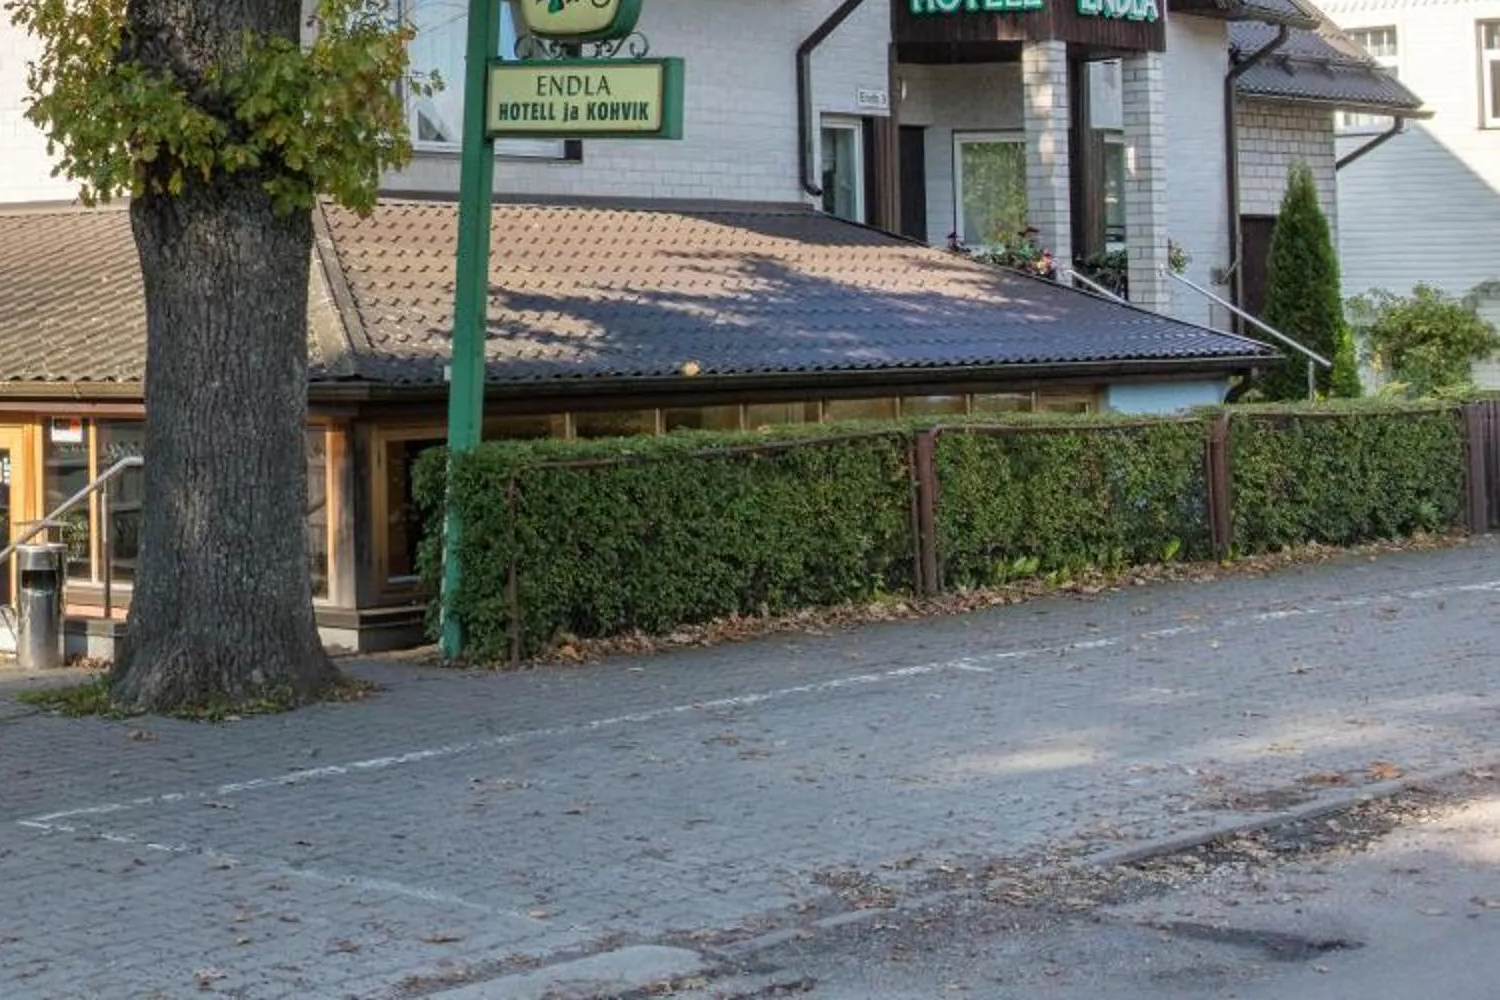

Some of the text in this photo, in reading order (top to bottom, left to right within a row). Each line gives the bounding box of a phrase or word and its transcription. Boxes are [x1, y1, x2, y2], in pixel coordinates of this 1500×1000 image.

[536, 75, 611, 96] ENDLA
[499, 101, 649, 122] HOTELL ja KOHVIK
